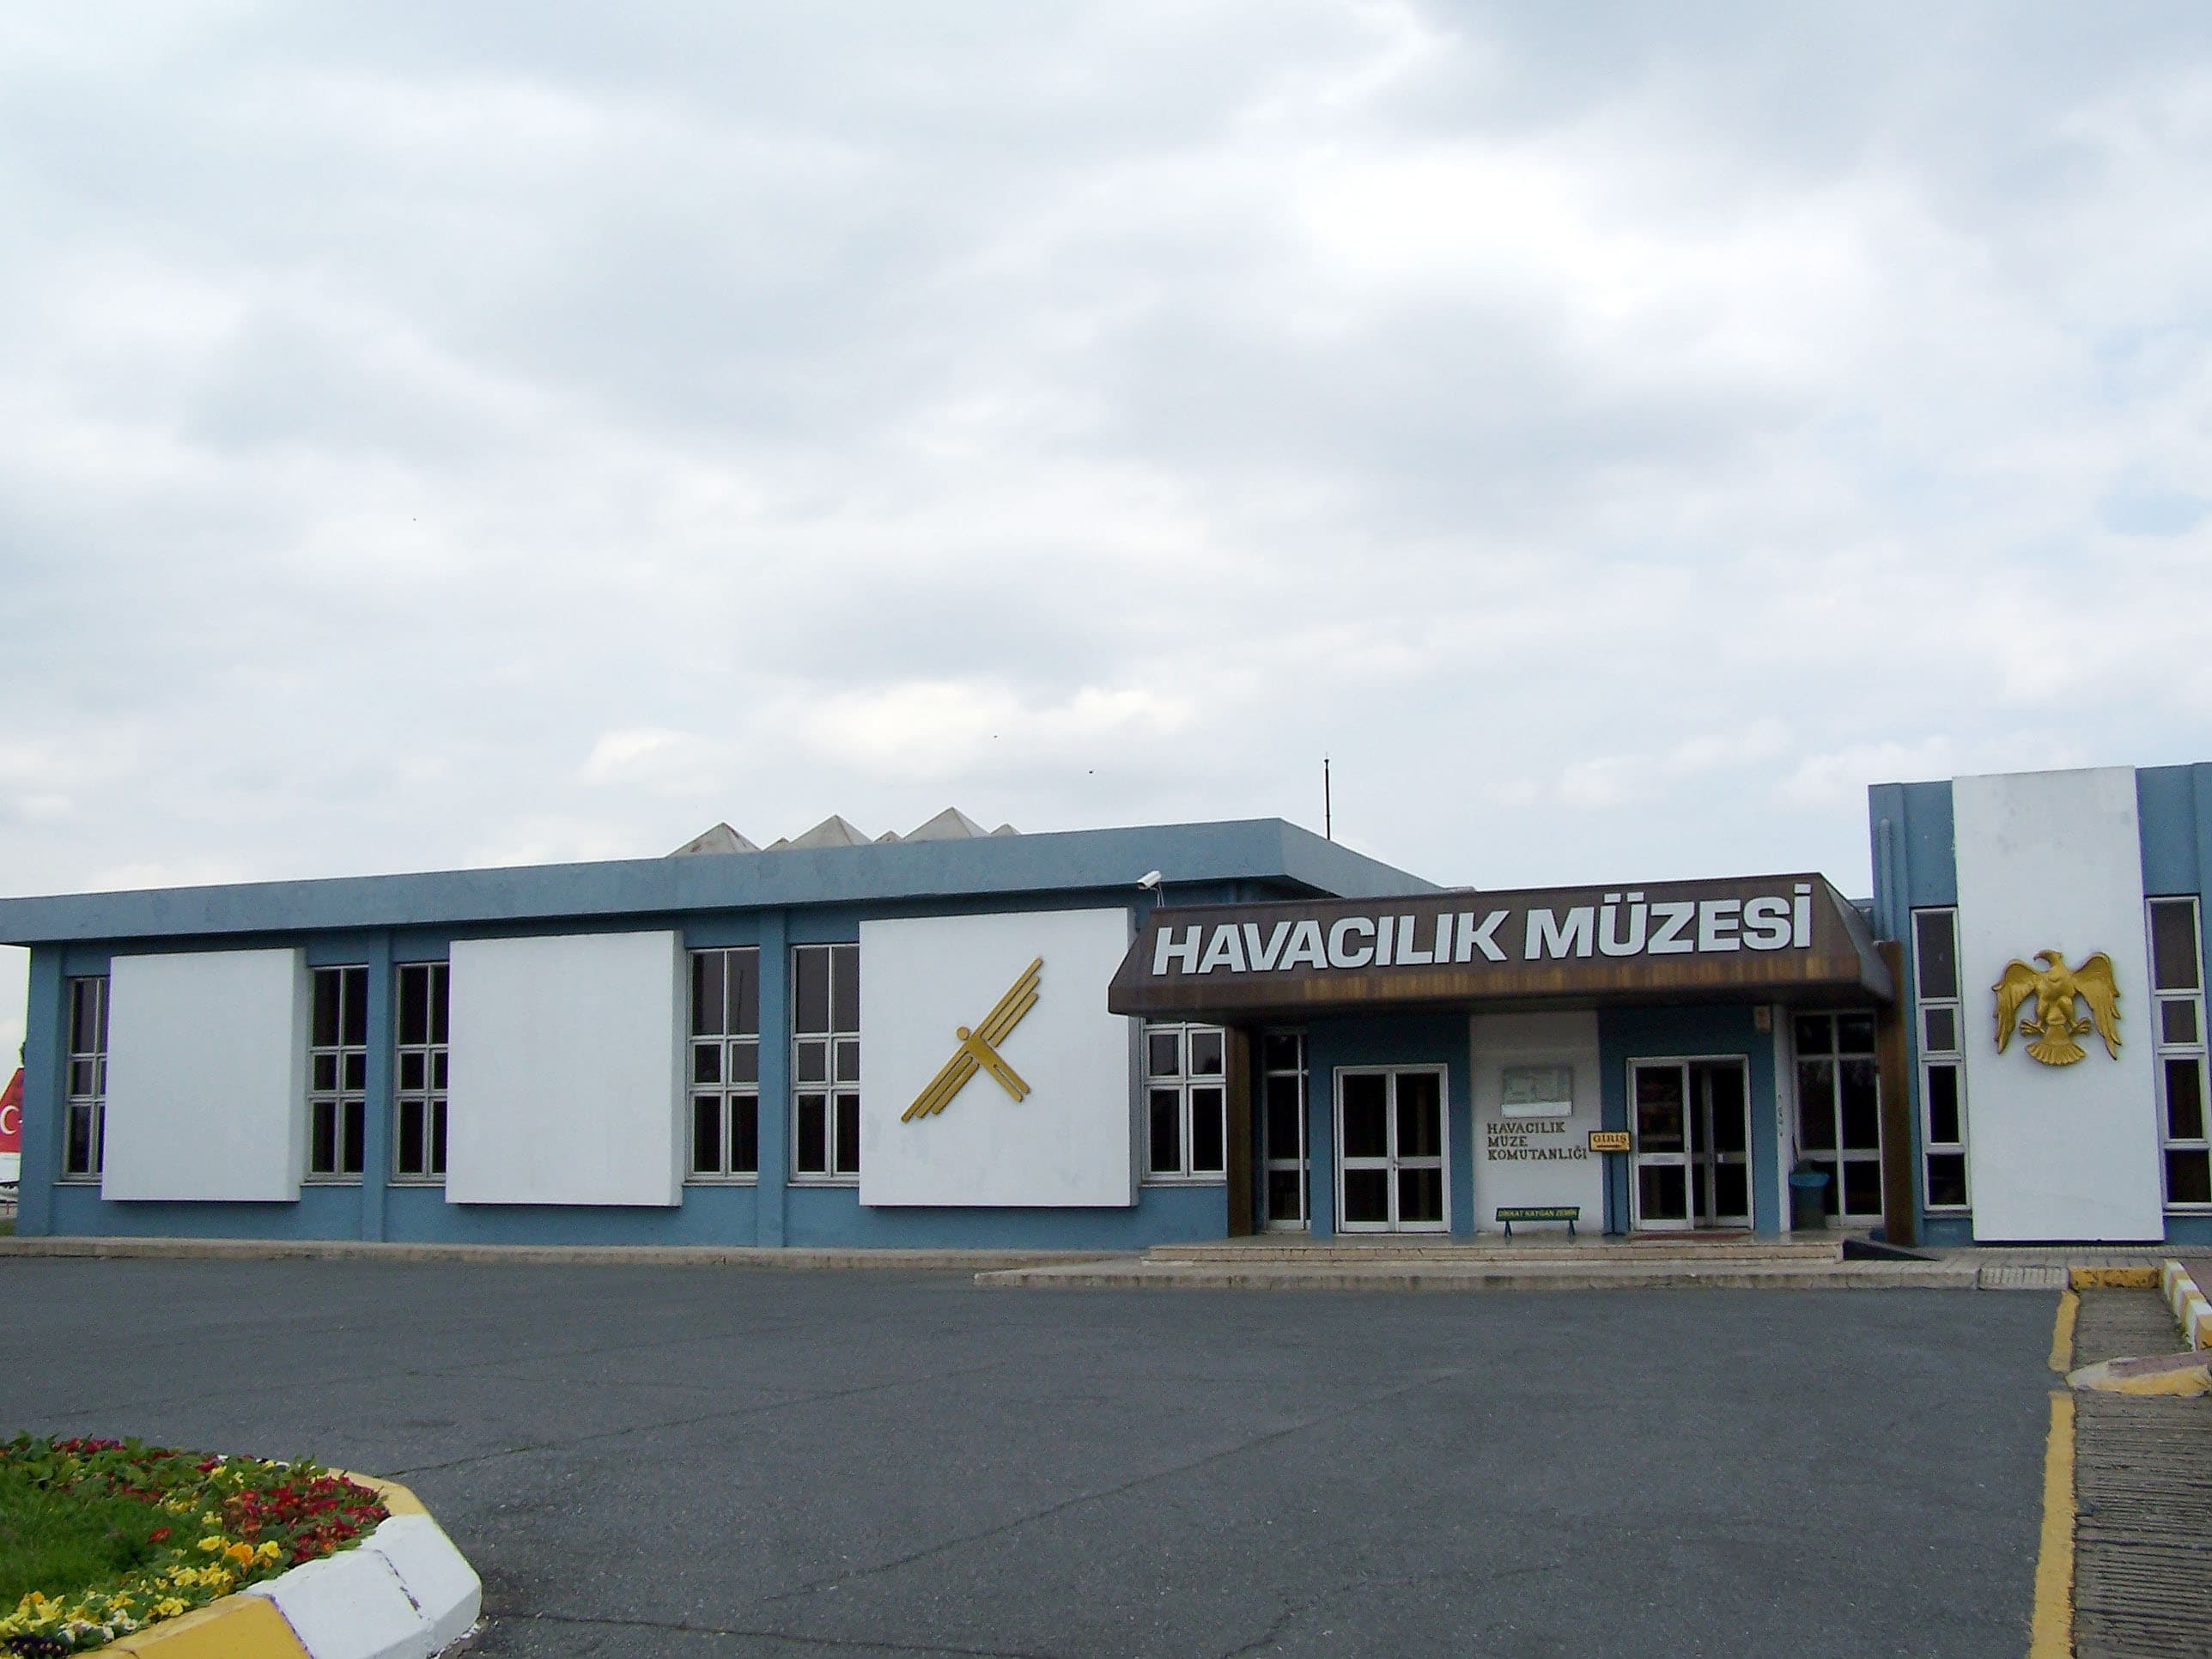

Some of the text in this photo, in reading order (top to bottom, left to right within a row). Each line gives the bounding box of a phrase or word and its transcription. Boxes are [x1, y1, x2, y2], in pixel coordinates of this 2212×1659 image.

[1152, 884, 1811, 975] HAVACILIK MÜZESİ
[1487, 1122, 1565, 1133] HAVACILIK
[1488, 1146, 1587, 1160] KOMUTANLIĞI
